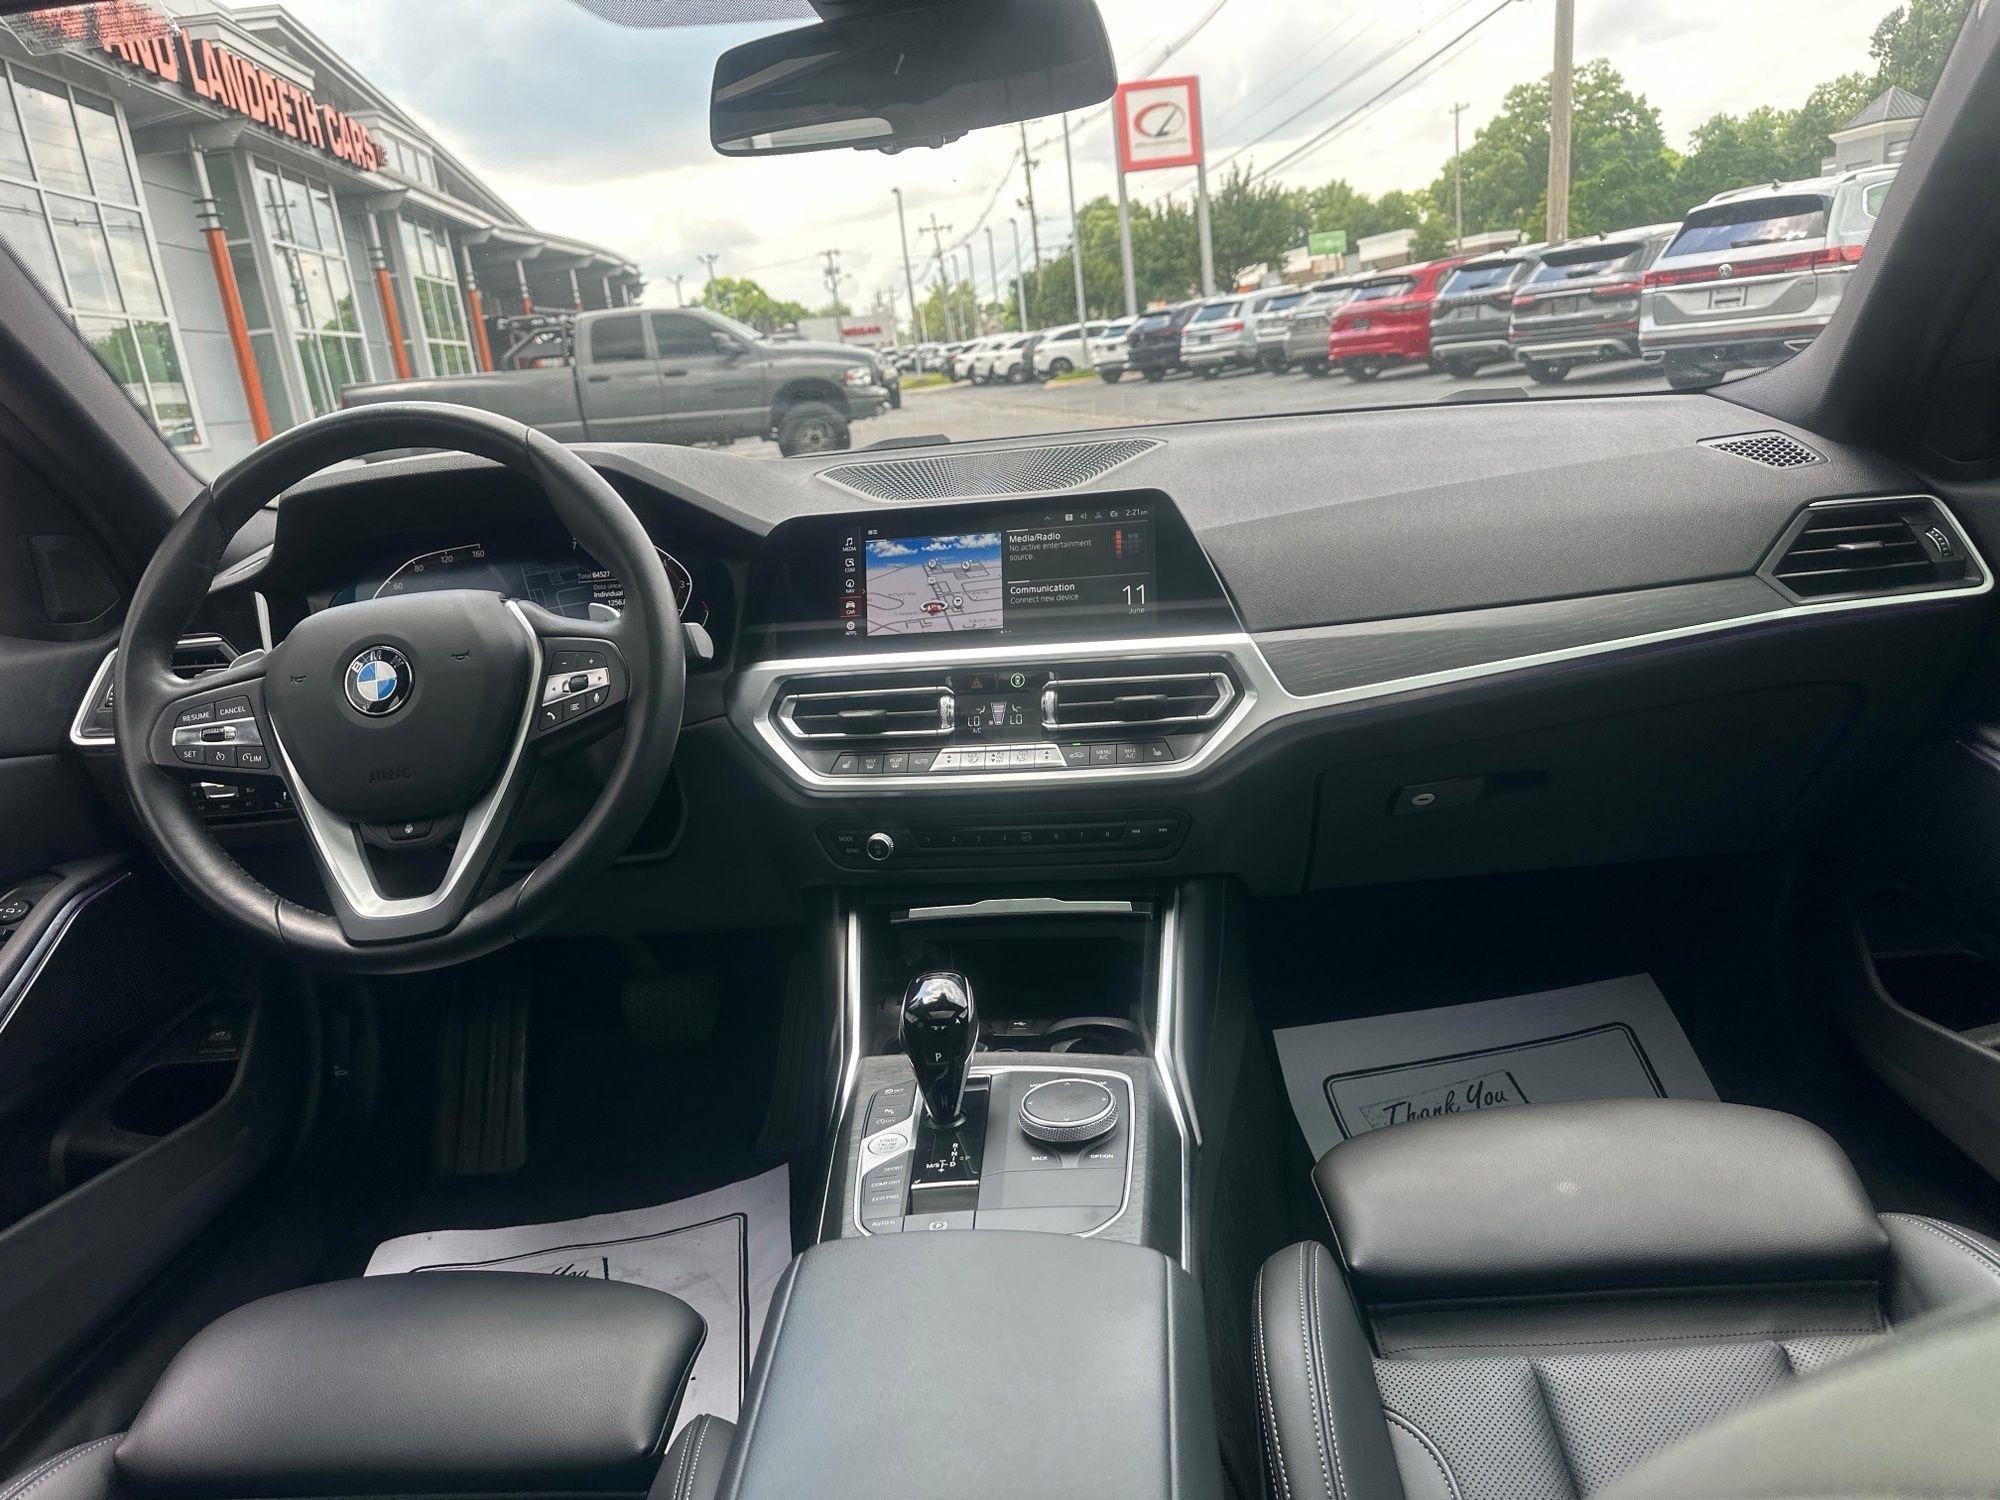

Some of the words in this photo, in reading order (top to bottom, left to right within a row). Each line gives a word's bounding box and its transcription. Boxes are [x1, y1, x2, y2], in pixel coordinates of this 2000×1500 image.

[181, 27, 326, 150] LANDRETH
[322, 102, 379, 173] CARS
[1009, 532, 1061, 543] Media/Radio
[572, 542, 577, 550] 7
[1042, 539, 1092, 549] entertainment
[441, 555, 454, 563] 120
[472, 550, 485, 558] 160
[1009, 553, 1035, 561] source.
[414, 564, 424, 572] 80
[393, 582, 403, 590] 60
[1010, 583, 1075, 594] Communication
[1010, 596, 1040, 604] Connect
[1056, 593, 1079, 601] device
[1122, 584, 1145, 605] 11
[351, 650, 405, 674] BMW
[219, 706, 246, 715] CANCEL
[182, 711, 211, 722] RESUME
[967, 716, 980, 727] LO
[1010, 713, 1023, 725] LO
[935, 1052, 942, 1062] P
[1382, 1089, 1461, 1125] Thank
[1466, 1080, 1509, 1109] You
